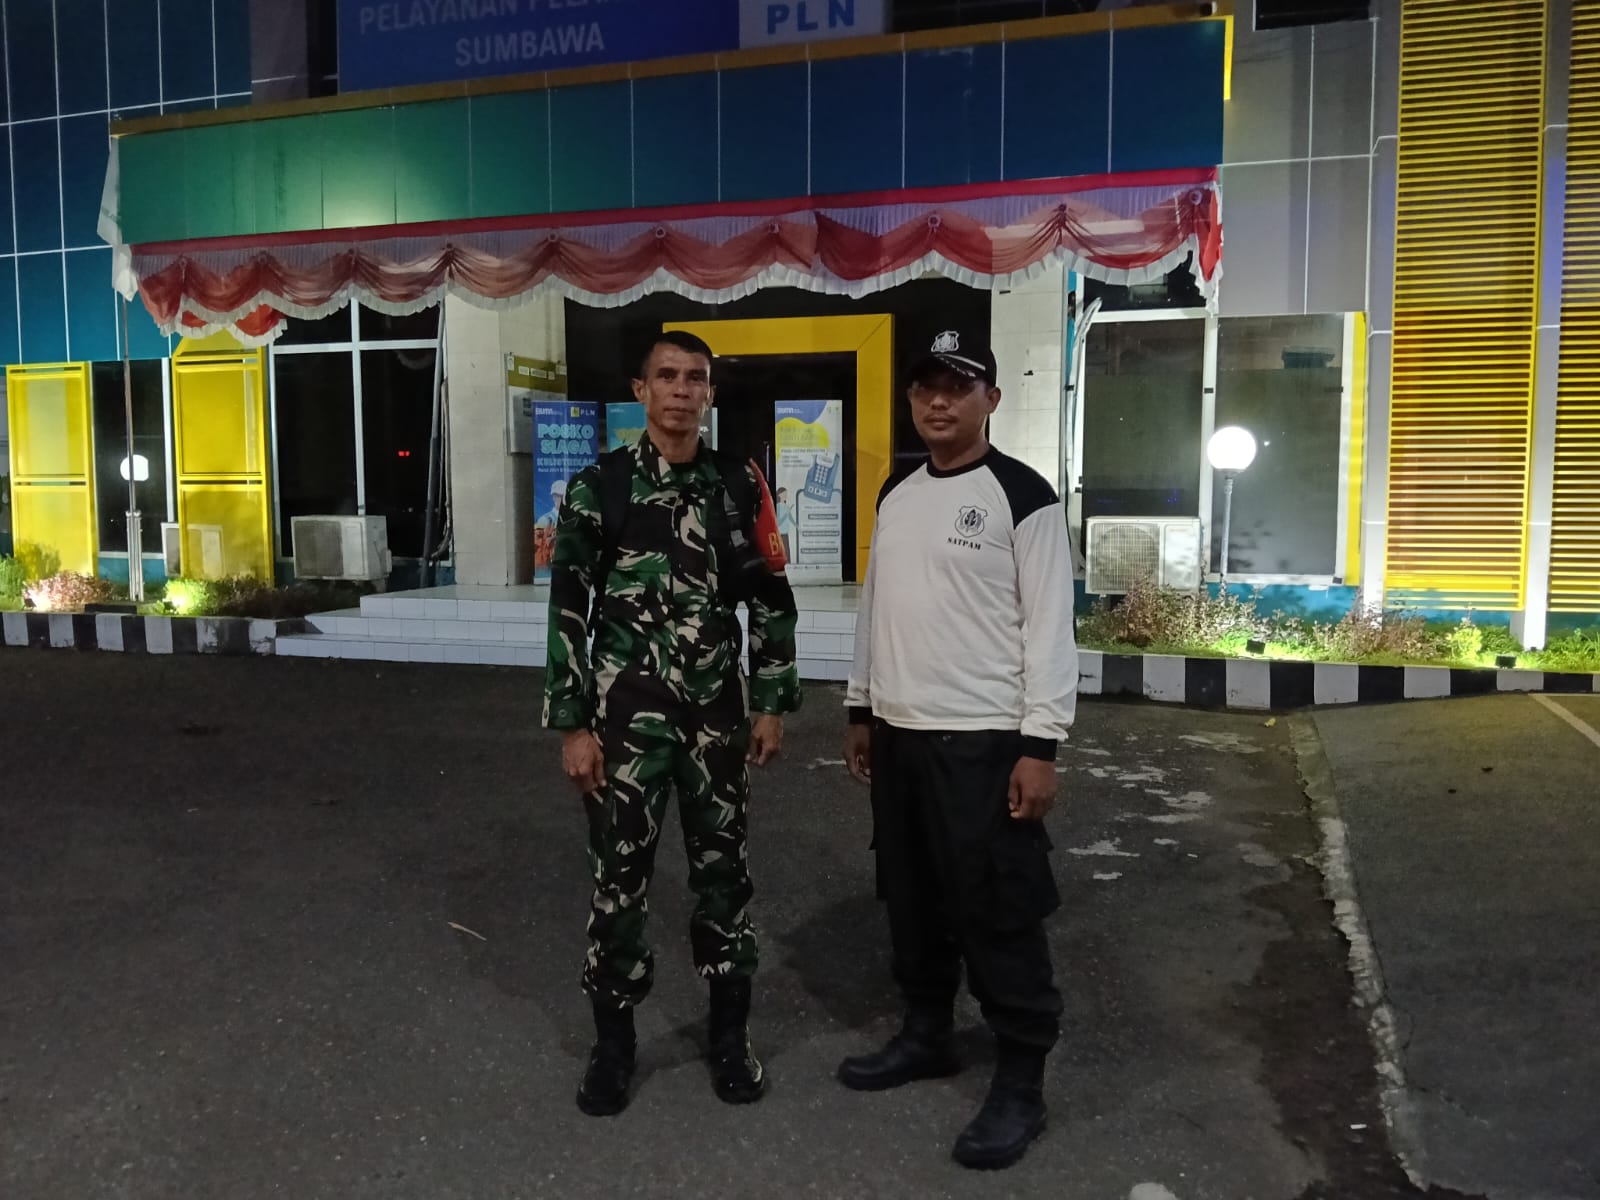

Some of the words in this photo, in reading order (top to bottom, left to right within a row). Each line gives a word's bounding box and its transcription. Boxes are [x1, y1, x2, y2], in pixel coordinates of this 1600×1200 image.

[767, 0, 855, 35] PLN
[455, 21, 606, 67] SUMBAWA
[580, 408, 595, 416] PLN
[537, 423, 594, 440] POSKO
[541, 440, 592, 455] SIAGA
[946, 537, 981, 550] SATPAM
